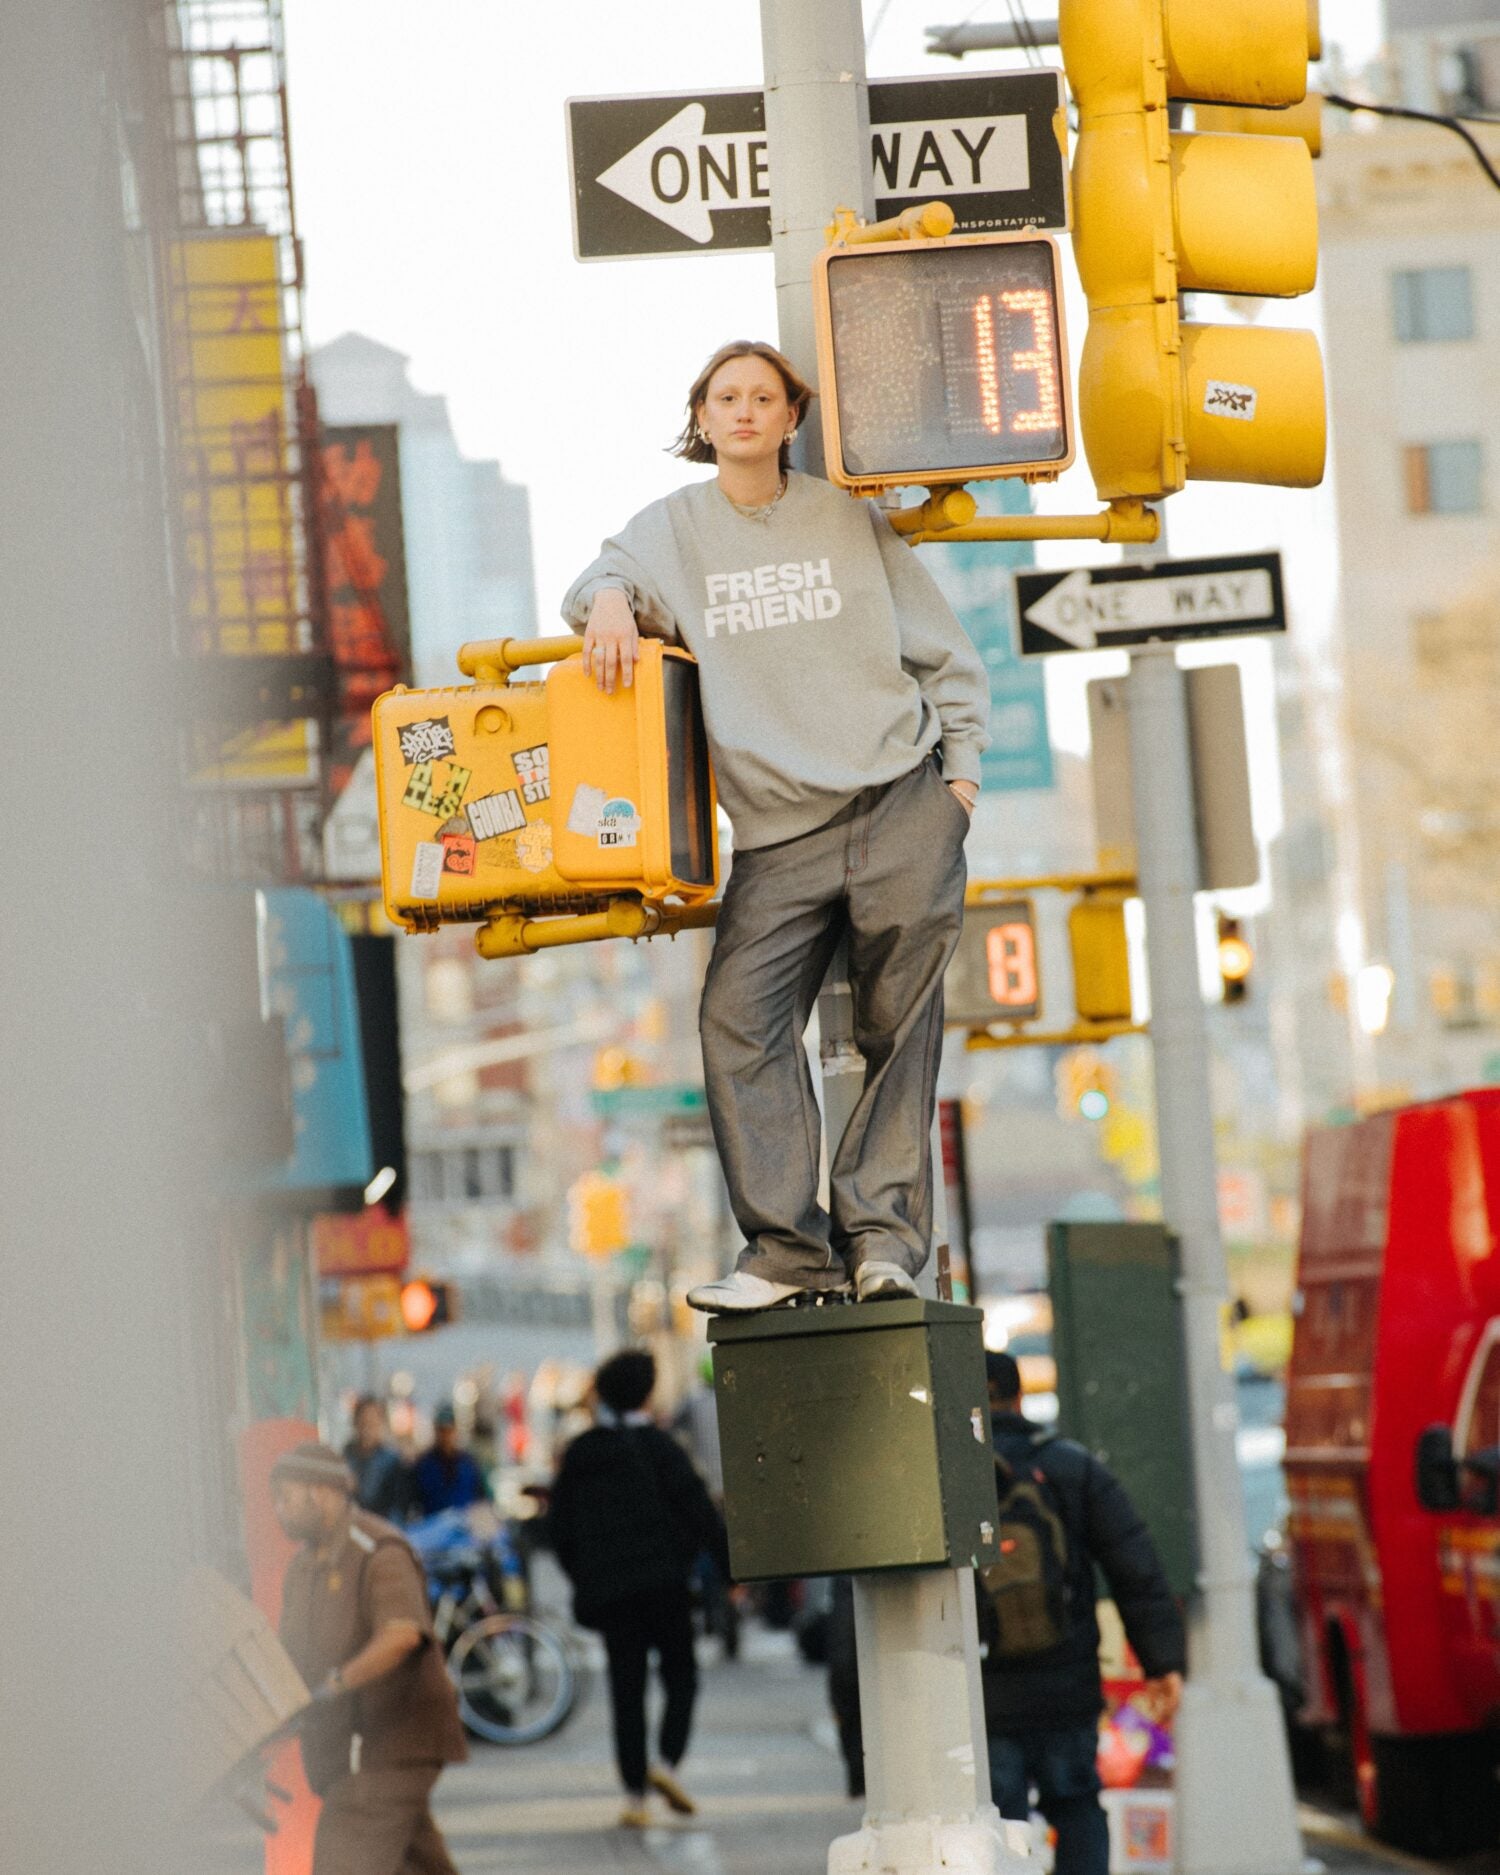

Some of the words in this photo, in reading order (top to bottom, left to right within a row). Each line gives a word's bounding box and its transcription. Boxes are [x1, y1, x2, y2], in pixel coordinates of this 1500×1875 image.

[649, 141, 769, 204] ONE
[872, 127, 997, 190] WAY
[952, 216, 1046, 229] ANSPORTATION
[974, 288, 1060, 435] 13
[705, 558, 832, 605] FRESH
[1056, 588, 1129, 624] ONE
[1172, 580, 1247, 614] WAY
[704, 588, 841, 638] FRIEND
[986, 923, 1038, 1006] 8
